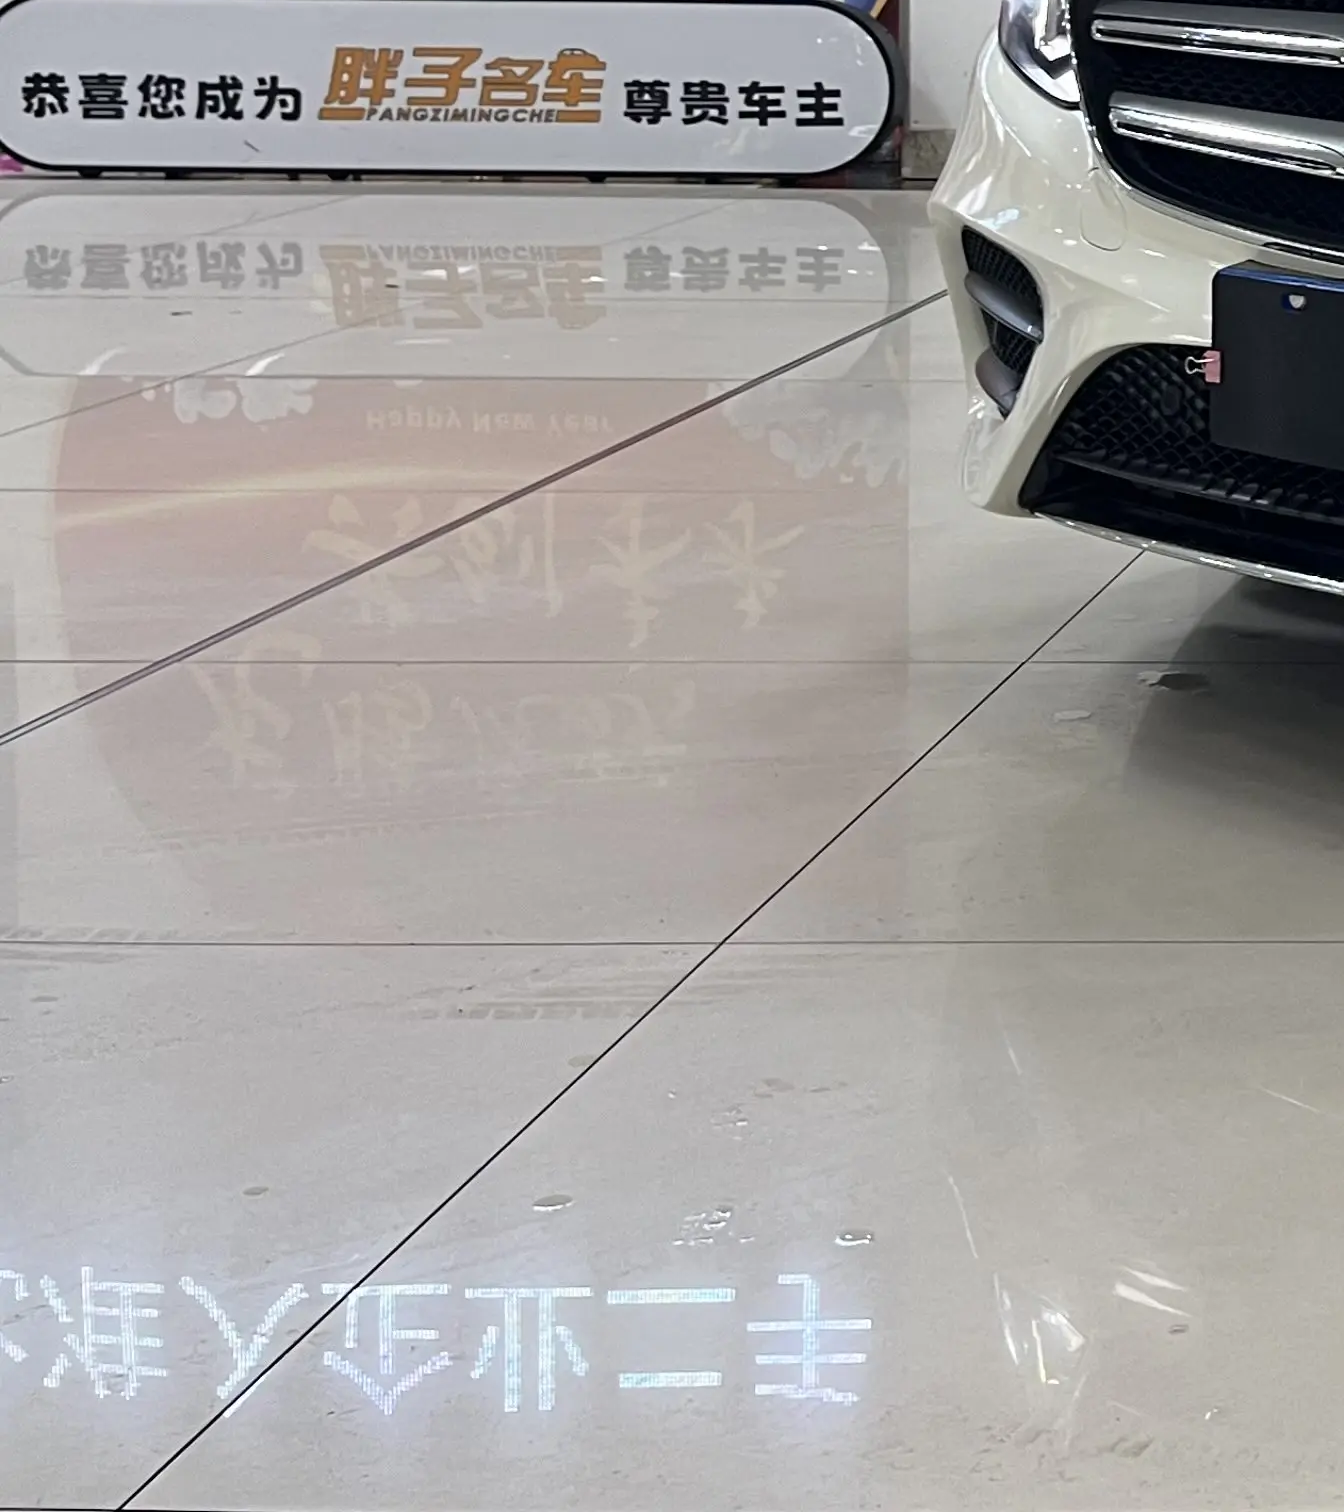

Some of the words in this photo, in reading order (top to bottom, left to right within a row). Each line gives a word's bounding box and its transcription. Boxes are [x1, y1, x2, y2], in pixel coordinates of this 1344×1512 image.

[20, 72, 303, 122] 恭喜您成为
[320, 47, 607, 108] 胖子名车
[622, 79, 846, 128] 尊贵车主
[366, 106, 558, 124] PANGZIMINGCHE
